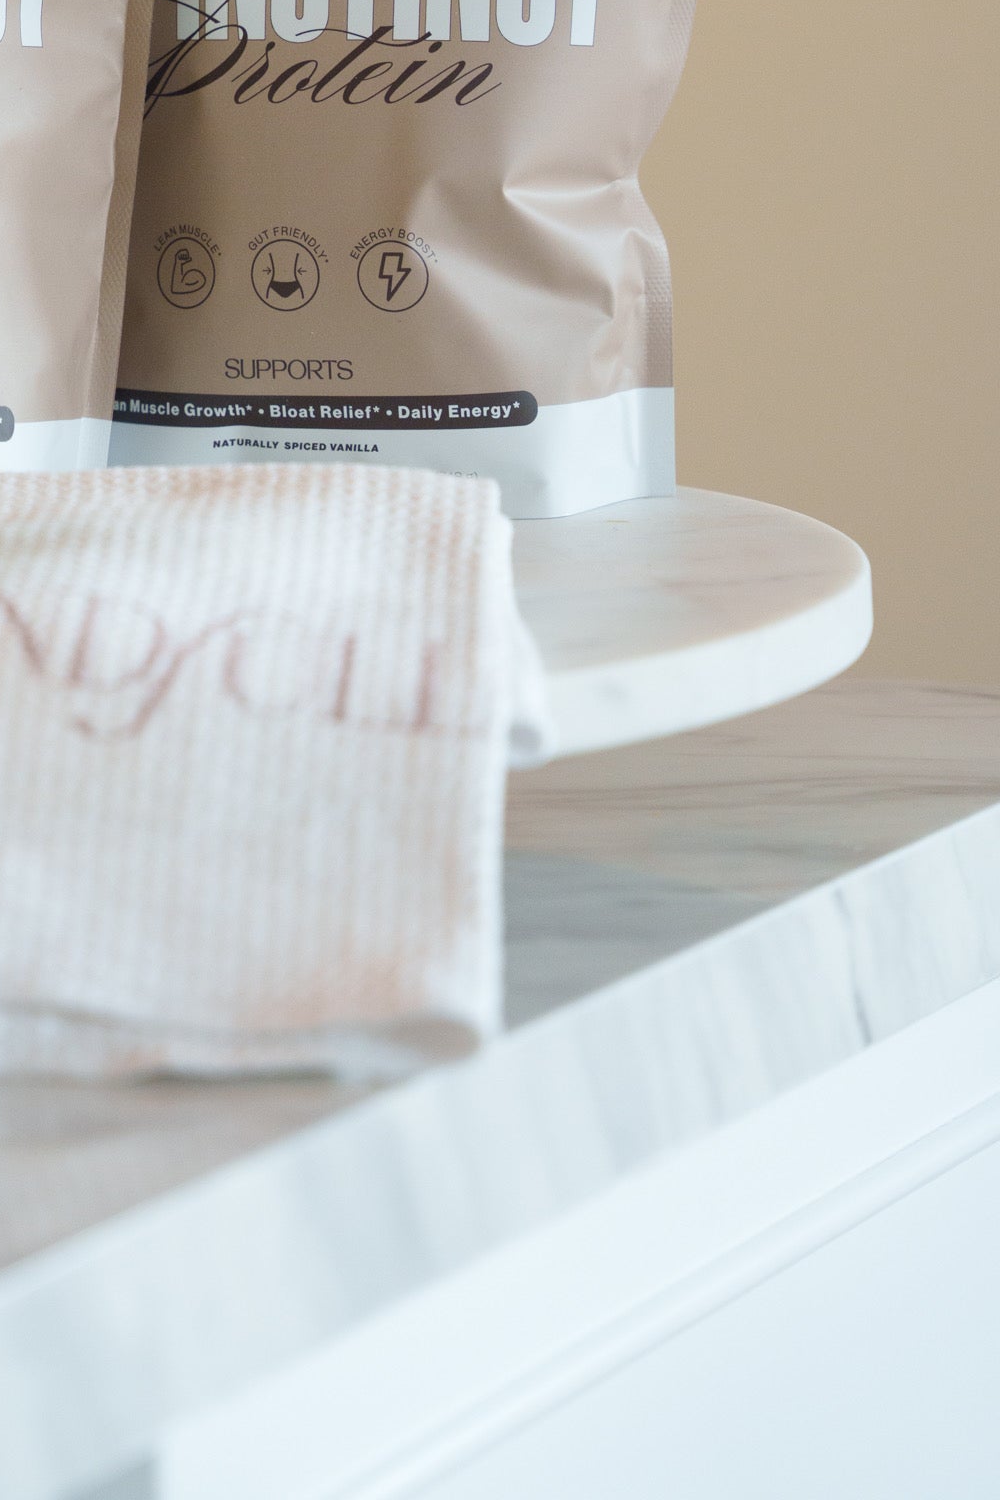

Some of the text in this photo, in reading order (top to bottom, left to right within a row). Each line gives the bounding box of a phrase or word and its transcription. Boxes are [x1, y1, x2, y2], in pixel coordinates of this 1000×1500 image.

[153, 225, 177, 252] LEAN
[248, 229, 270, 251] GUT
[350, 227, 394, 260] ENERGY
[224, 358, 354, 381] SUPPORTS
[129, 398, 179, 416] Muscle
[269, 404, 316, 419] Bloat
[397, 404, 443, 422] Daily
[212, 438, 379, 453] NATURALLY SPICED VANILLA
